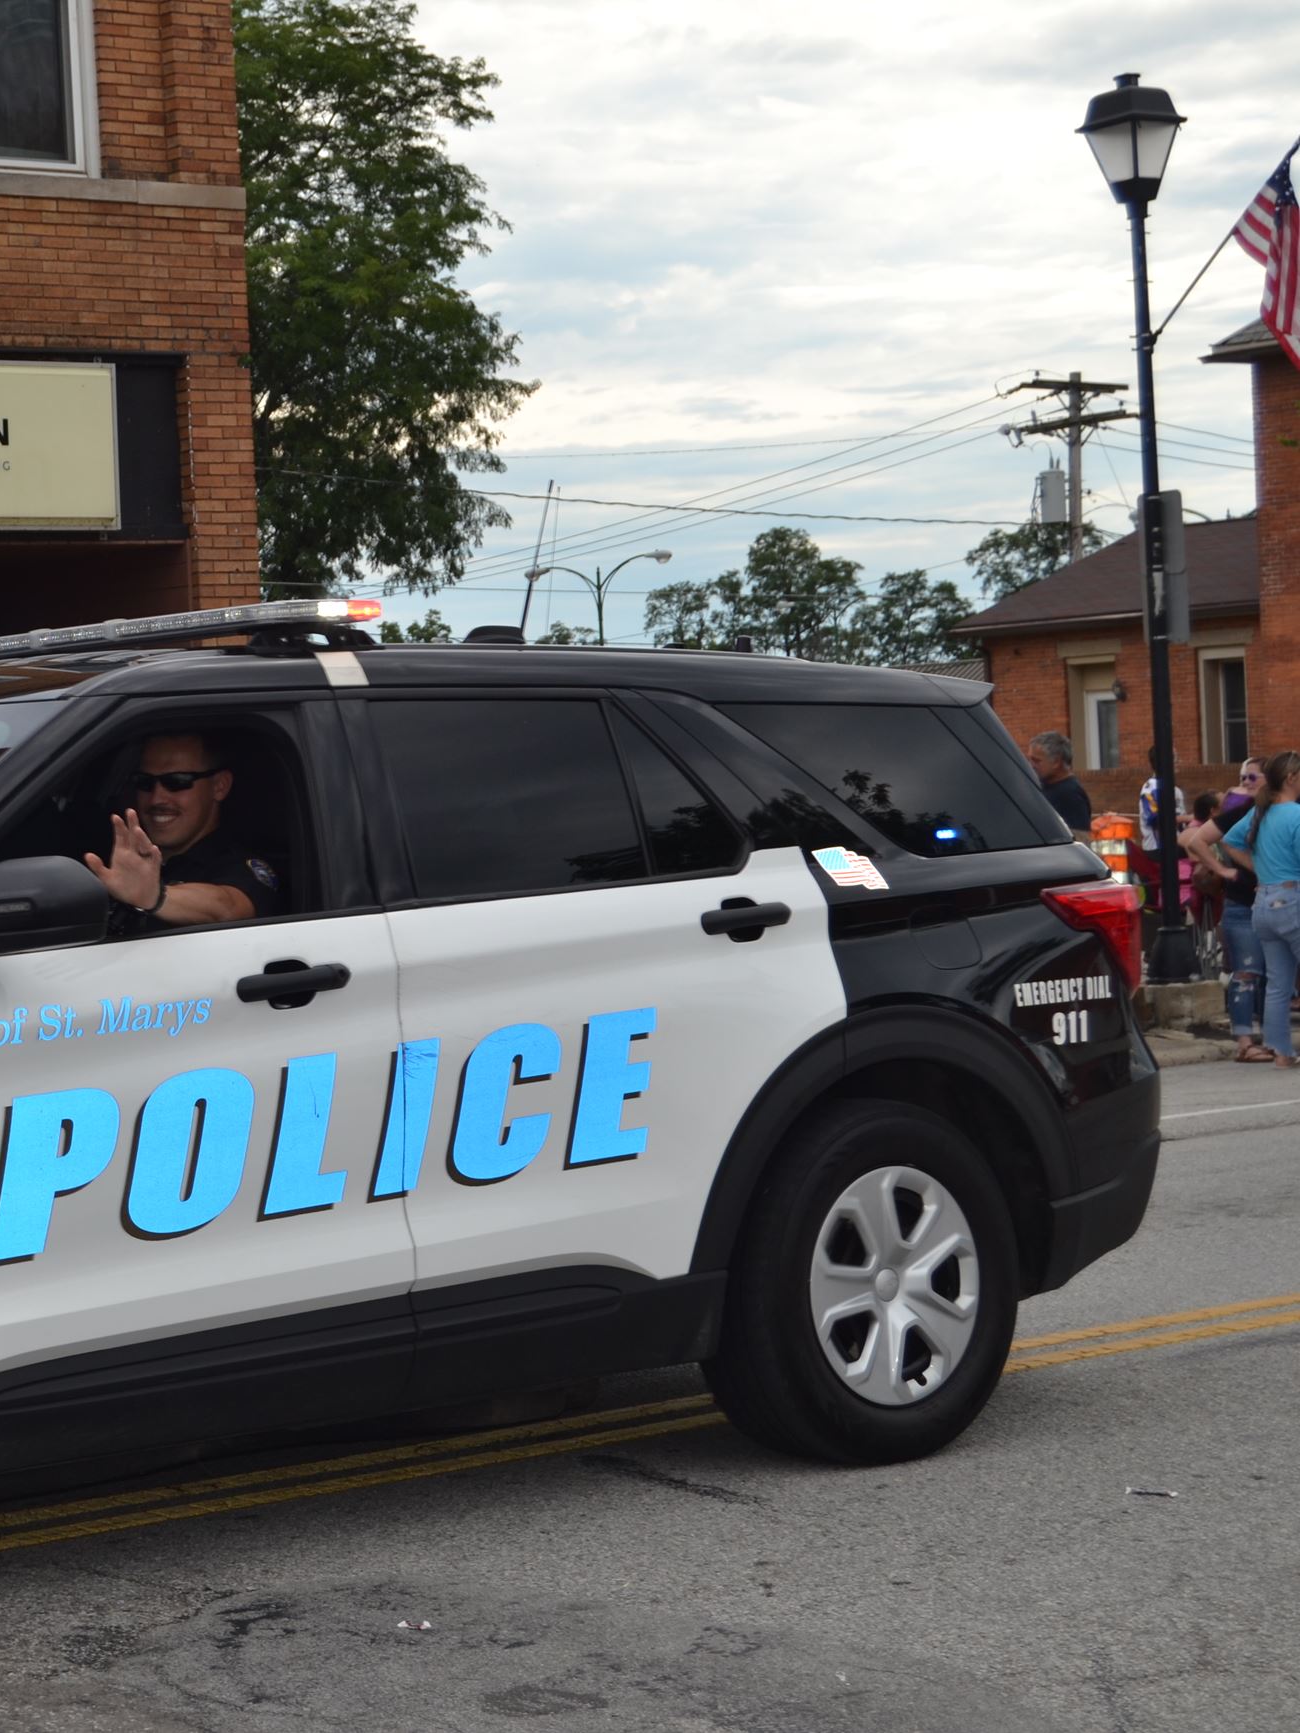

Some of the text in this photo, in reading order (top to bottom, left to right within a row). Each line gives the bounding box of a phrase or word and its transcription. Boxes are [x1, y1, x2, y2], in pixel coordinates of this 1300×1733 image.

[1013, 975, 1112, 1008] EMERGENCY DIAL
[38, 1004, 84, 1042] St.
[97, 996, 213, 1037] Marys
[1051, 1009, 1089, 1046] 911
